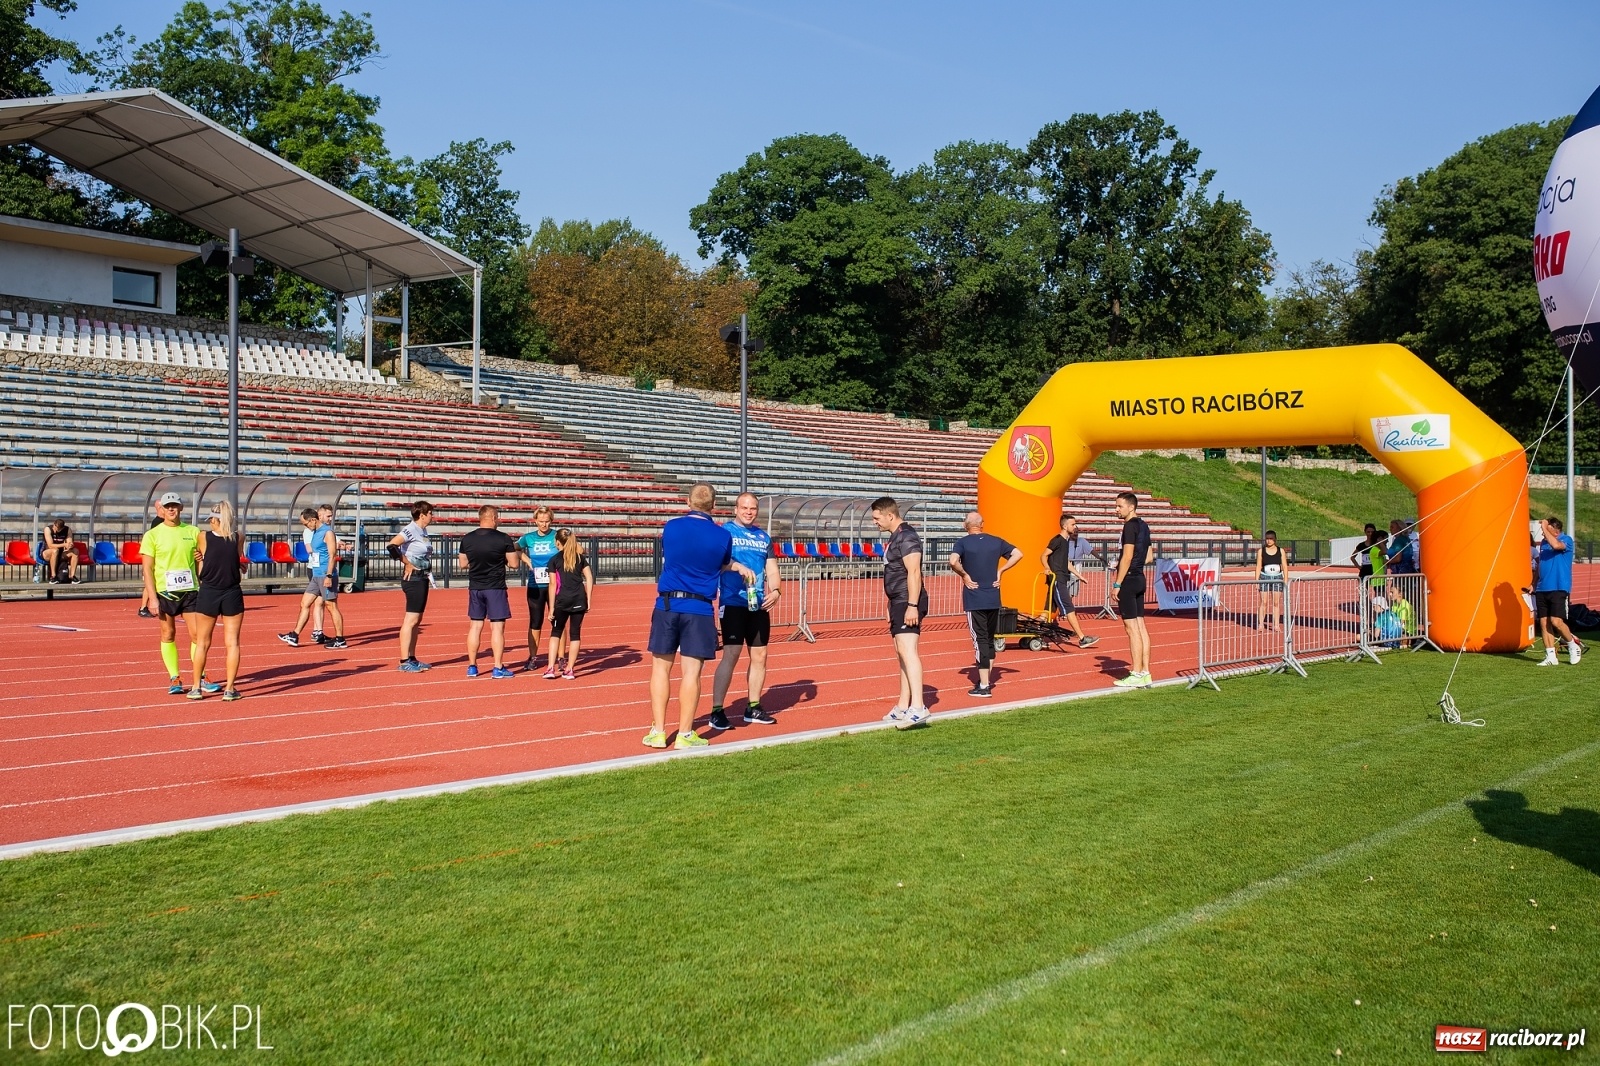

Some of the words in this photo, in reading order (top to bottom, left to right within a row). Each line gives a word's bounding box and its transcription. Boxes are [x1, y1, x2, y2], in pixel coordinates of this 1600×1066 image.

[1110, 397, 1185, 417] MIASTO
[1192, 388, 1304, 414] RACIBÓRZ
[1161, 564, 1215, 592] RAFAKO
[1174, 595, 1195, 605] GRUPA
